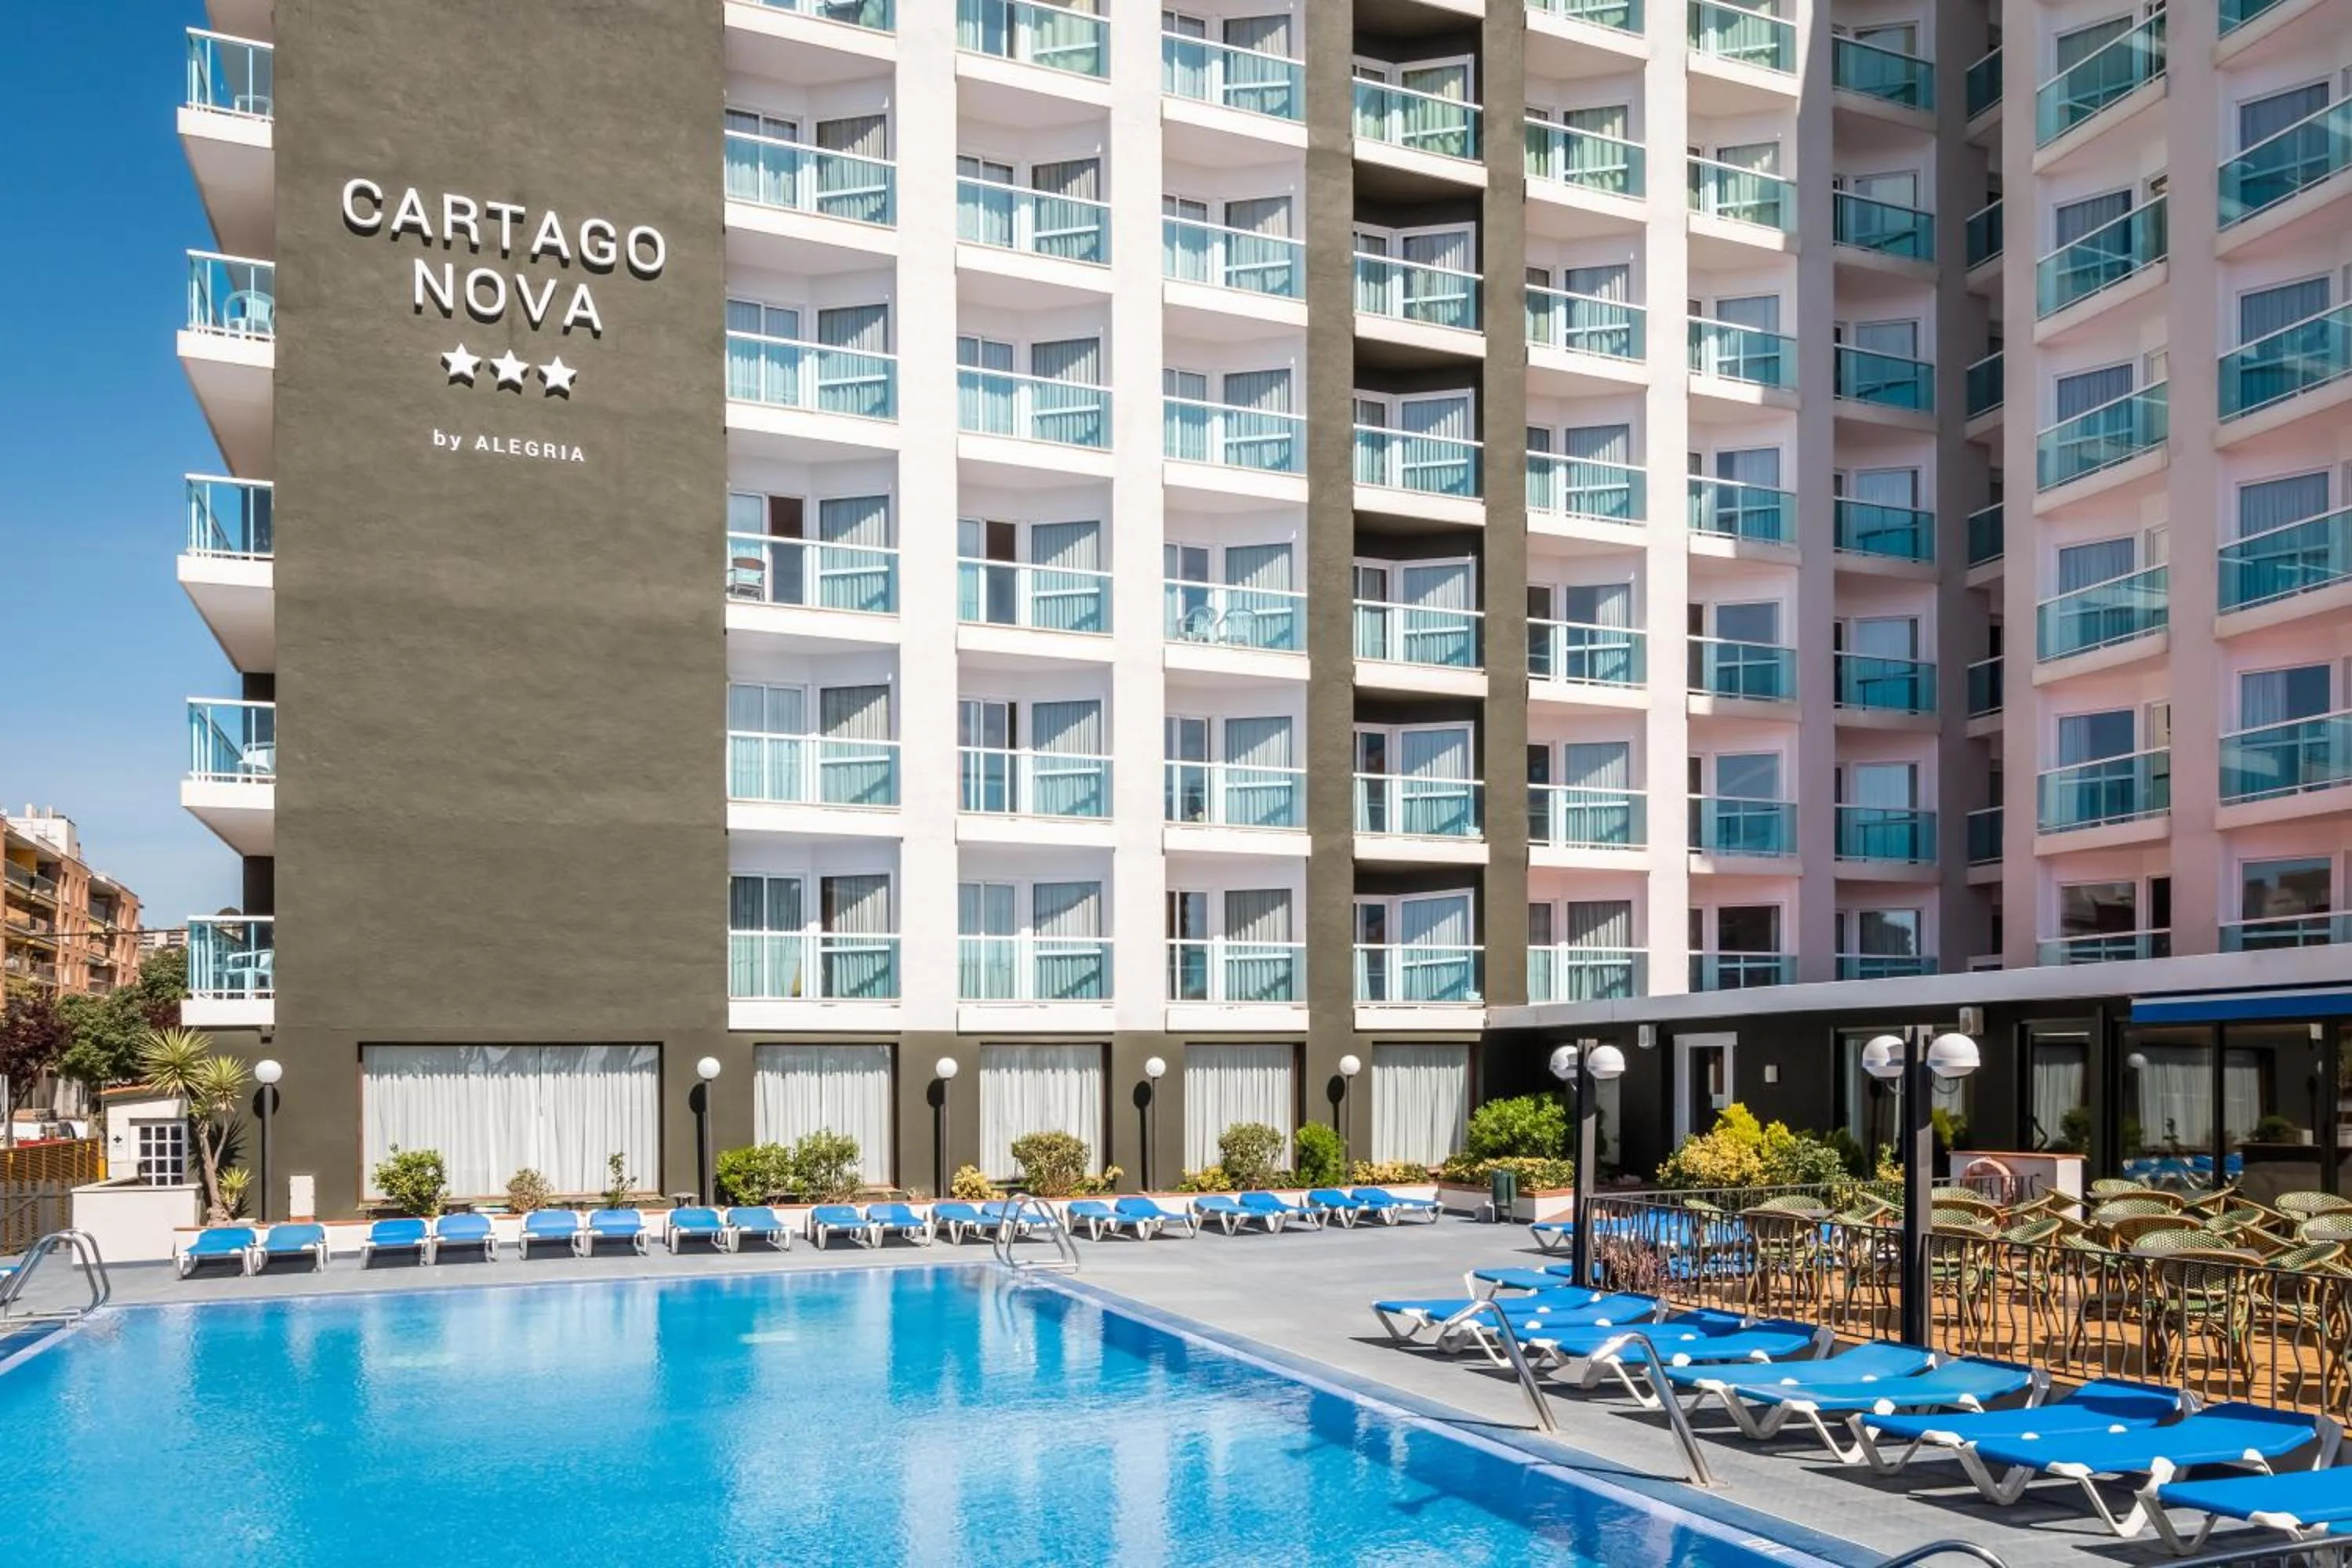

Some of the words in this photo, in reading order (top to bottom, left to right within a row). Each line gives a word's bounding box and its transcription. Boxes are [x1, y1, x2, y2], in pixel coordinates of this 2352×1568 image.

[342, 178, 666, 274] CARTAGO
[413, 258, 604, 333] NOVA
[433, 429, 462, 451] by
[474, 435, 586, 463] ALEGRIA
